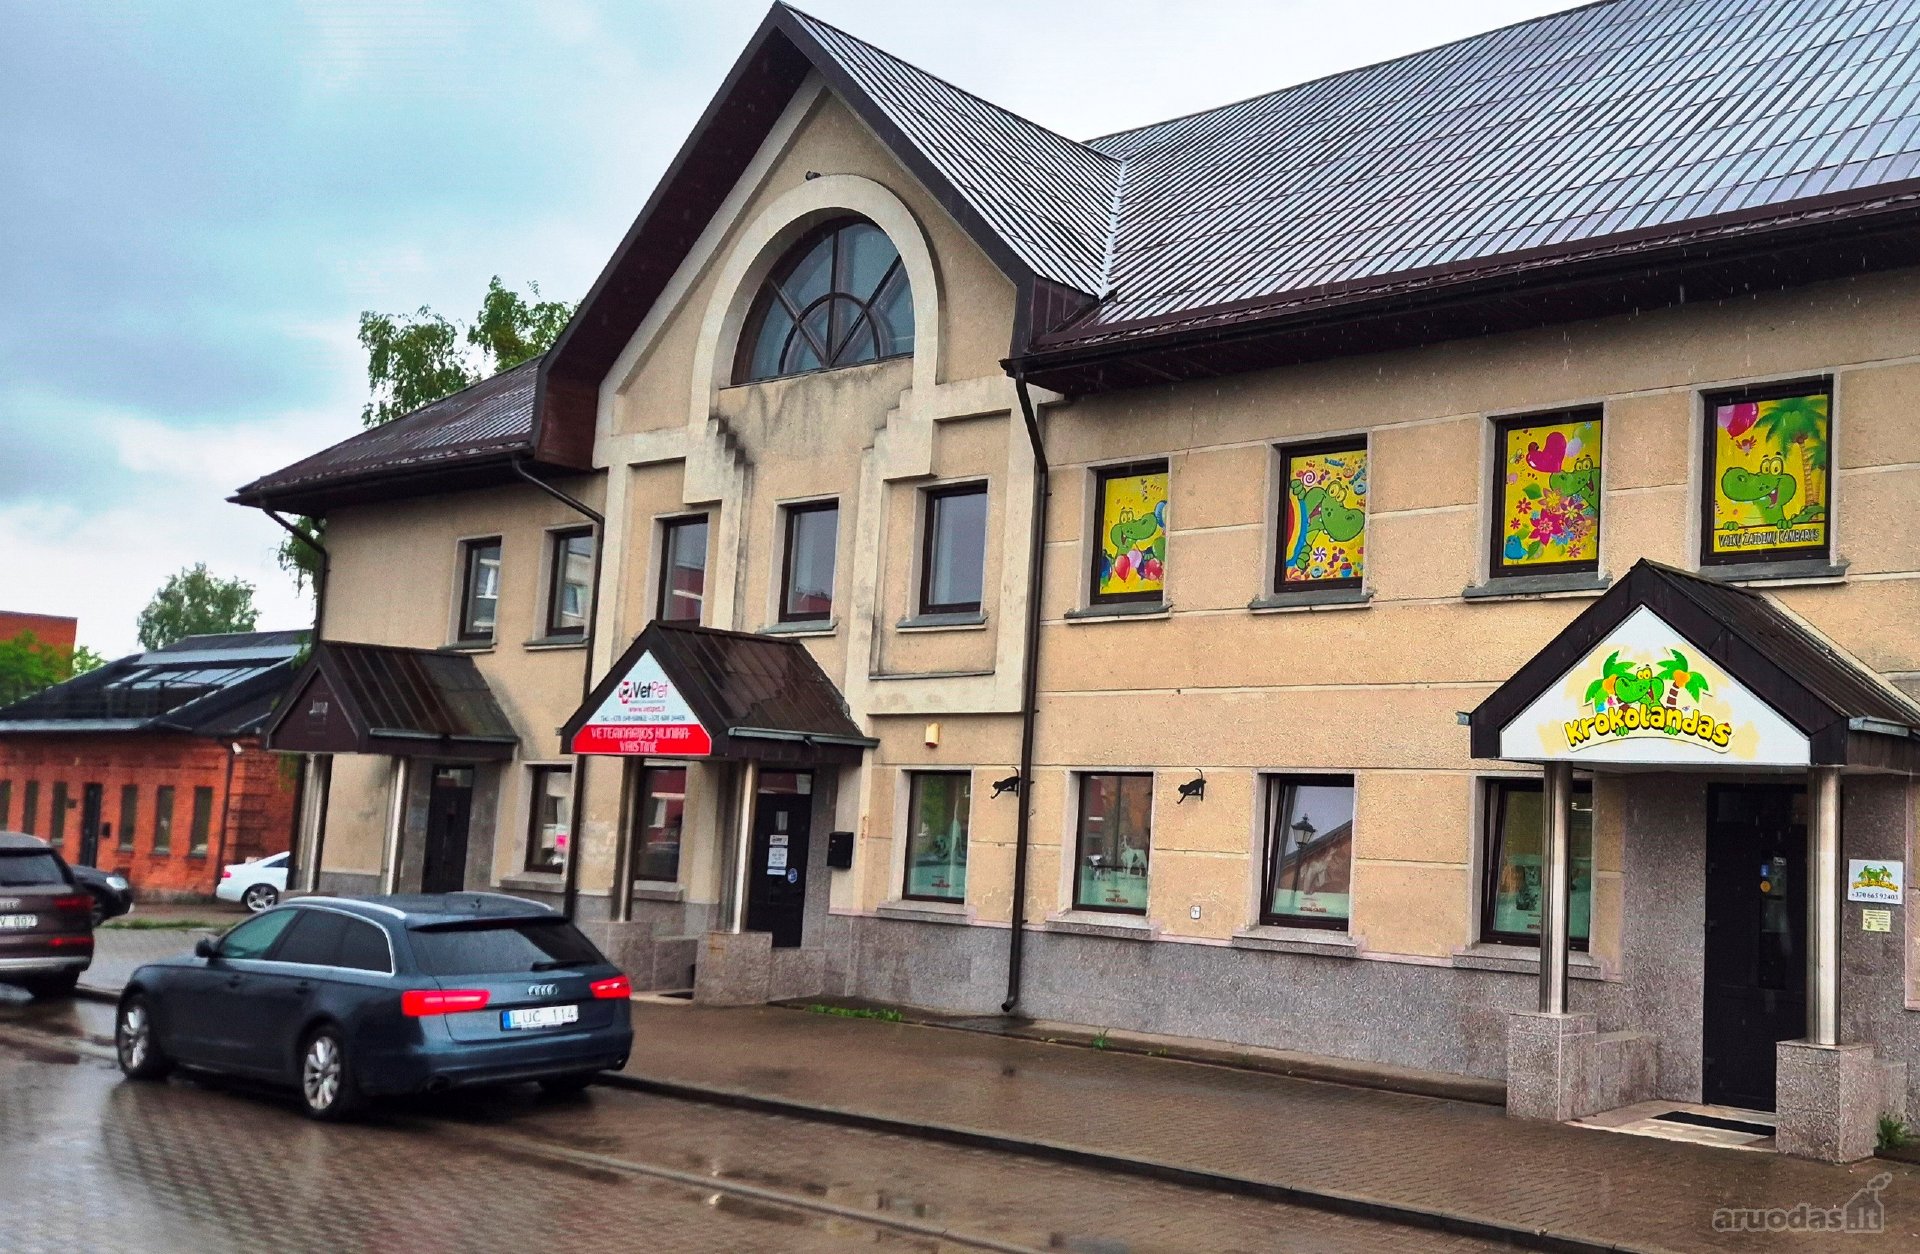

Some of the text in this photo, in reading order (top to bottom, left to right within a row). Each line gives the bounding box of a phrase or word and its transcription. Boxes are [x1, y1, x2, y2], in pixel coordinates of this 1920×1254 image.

[1779, 529, 1819, 543] KAMBARYS
[633, 681, 668, 698] VetPet
[1564, 703, 1732, 747] Krokolandas
[512, 1010, 541, 1024] LUC
